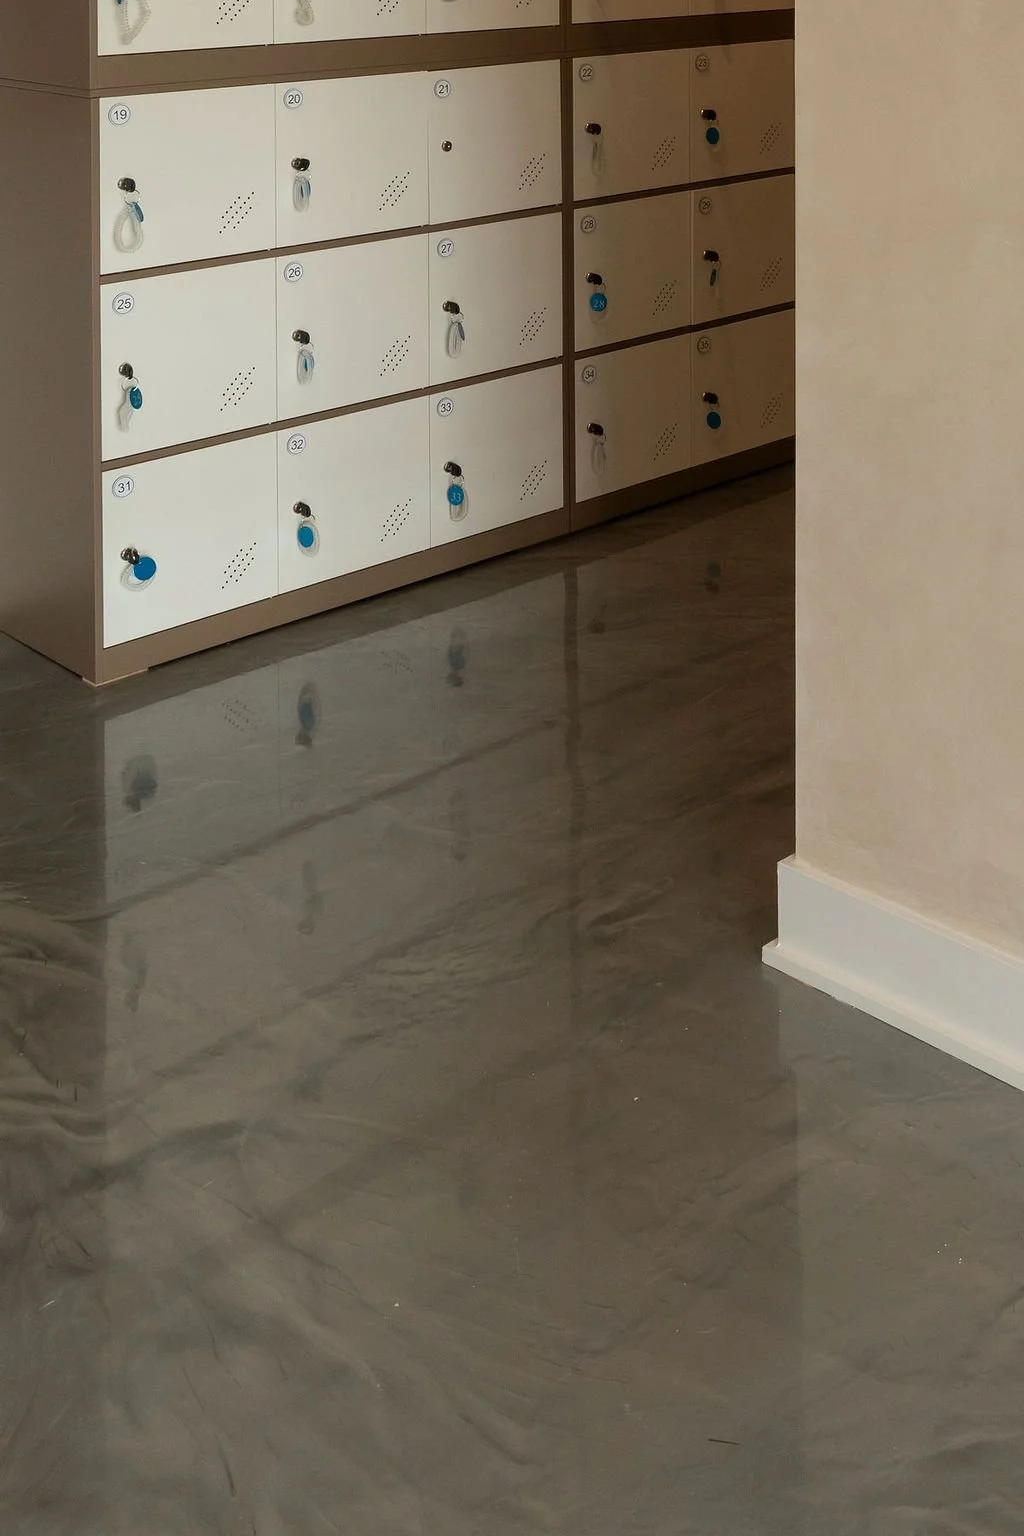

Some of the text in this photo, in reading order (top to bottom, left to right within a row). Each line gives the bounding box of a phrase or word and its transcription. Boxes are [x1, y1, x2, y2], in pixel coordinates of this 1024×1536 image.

[698, 58, 708, 68] 23
[582, 67, 593, 78] 22
[438, 83, 449, 95] 21
[287, 93, 301, 105] 20
[113, 108, 128, 121] 19
[583, 219, 594, 230] 28
[440, 242, 452, 254] 27
[288, 266, 301, 279] 26
[116, 297, 132, 310] 25
[593, 299, 605, 309] 28
[584, 369, 595, 380] 34
[440, 402, 452, 413] 33
[290, 439, 304, 451] 32
[117, 480, 131, 494] 31
[450, 491, 462, 502] 33
